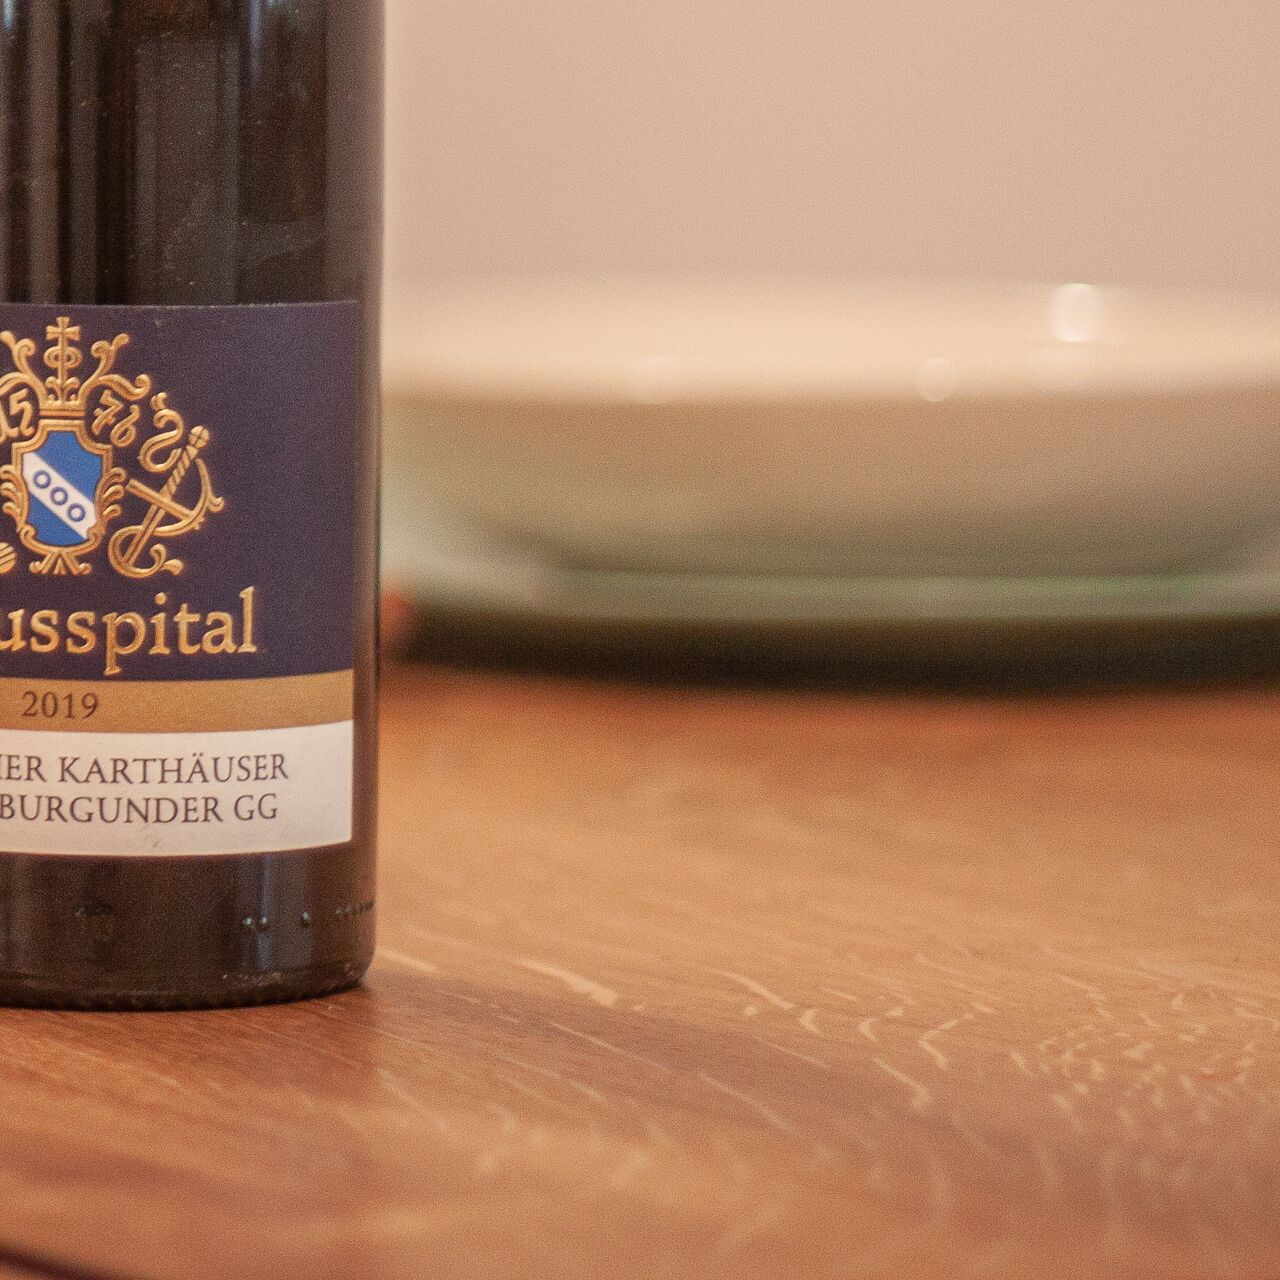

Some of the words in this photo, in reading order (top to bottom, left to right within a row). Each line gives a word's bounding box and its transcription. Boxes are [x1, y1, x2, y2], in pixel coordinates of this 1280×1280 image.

[21, 690, 99, 719] 2019
[57, 752, 289, 785] KARTHÄUSER
[233, 793, 278, 821] GG
